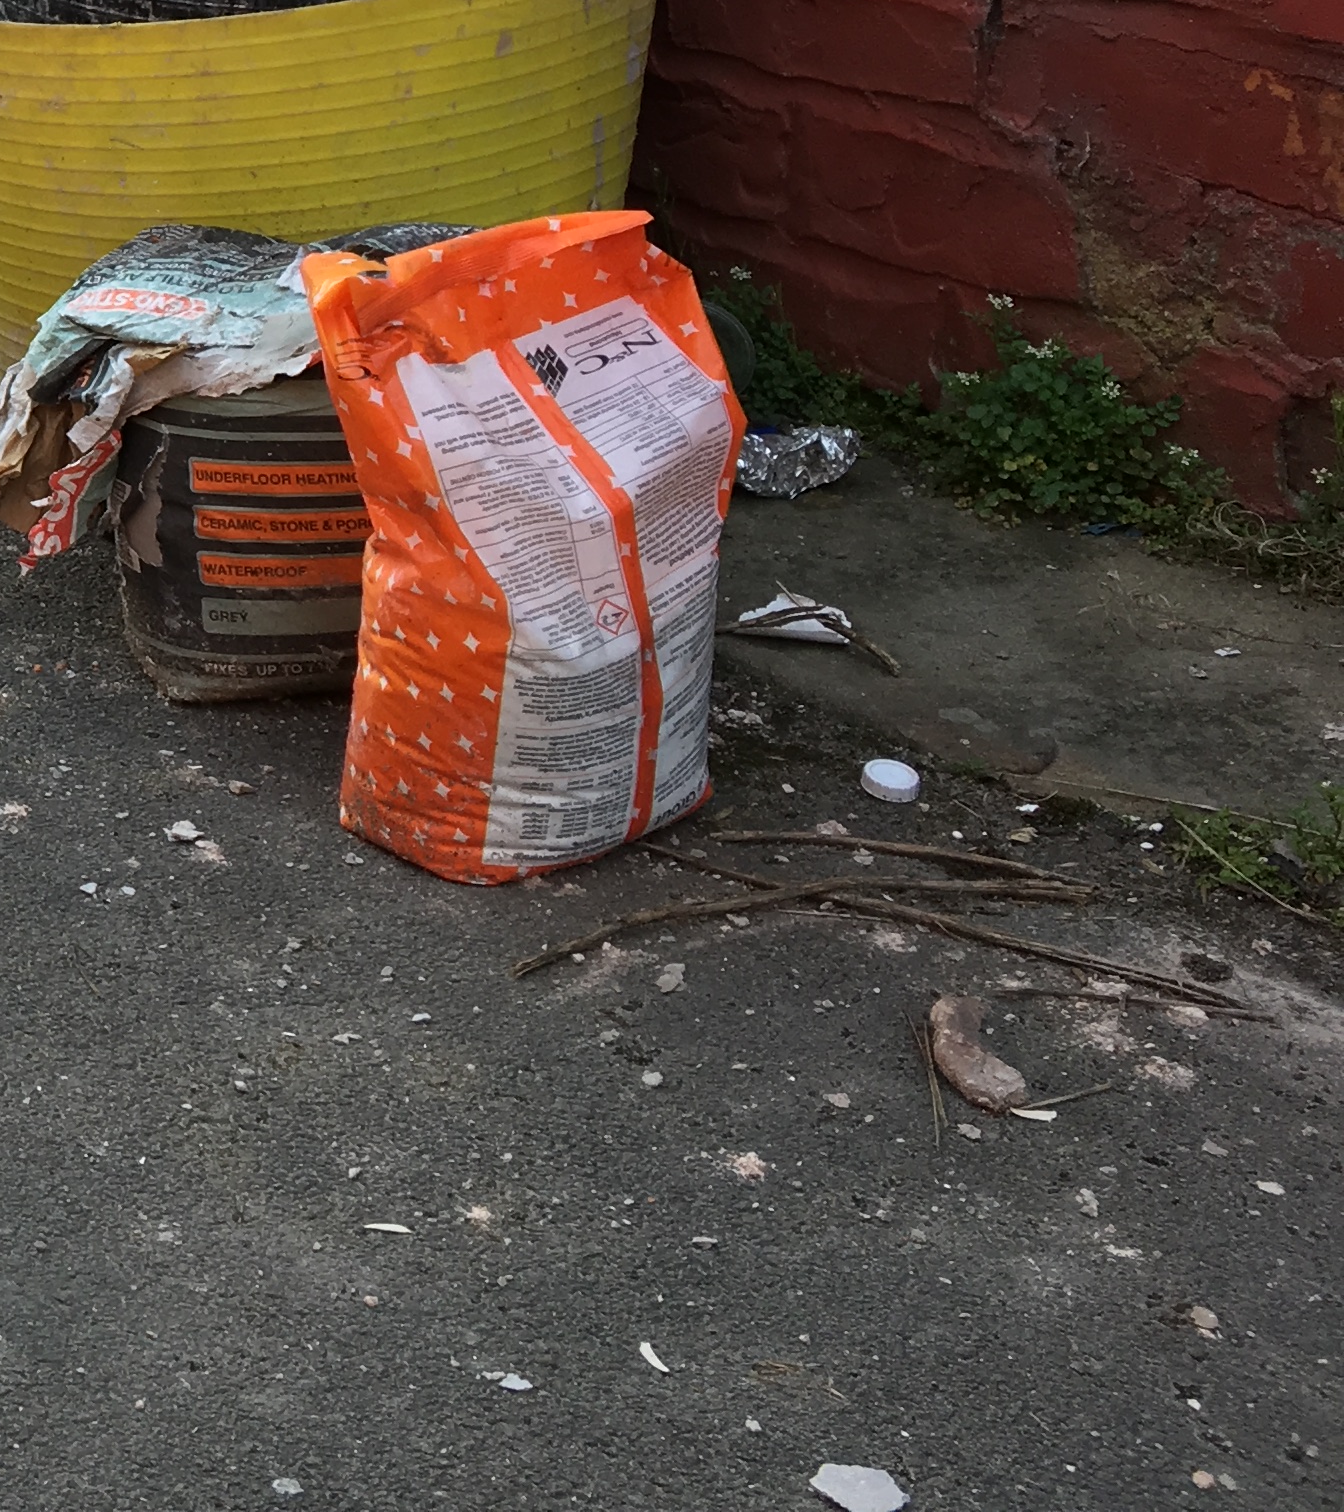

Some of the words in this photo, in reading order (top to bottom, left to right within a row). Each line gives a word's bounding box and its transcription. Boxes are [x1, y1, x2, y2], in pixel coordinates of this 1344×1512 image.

[194, 469, 292, 486] UNDERFLOOR
[270, 519, 321, 533] STONE
[322, 518, 334, 532] &
[202, 562, 308, 578] WATERPROOF
[208, 610, 249, 623] GREY
[256, 664, 278, 676] UP
